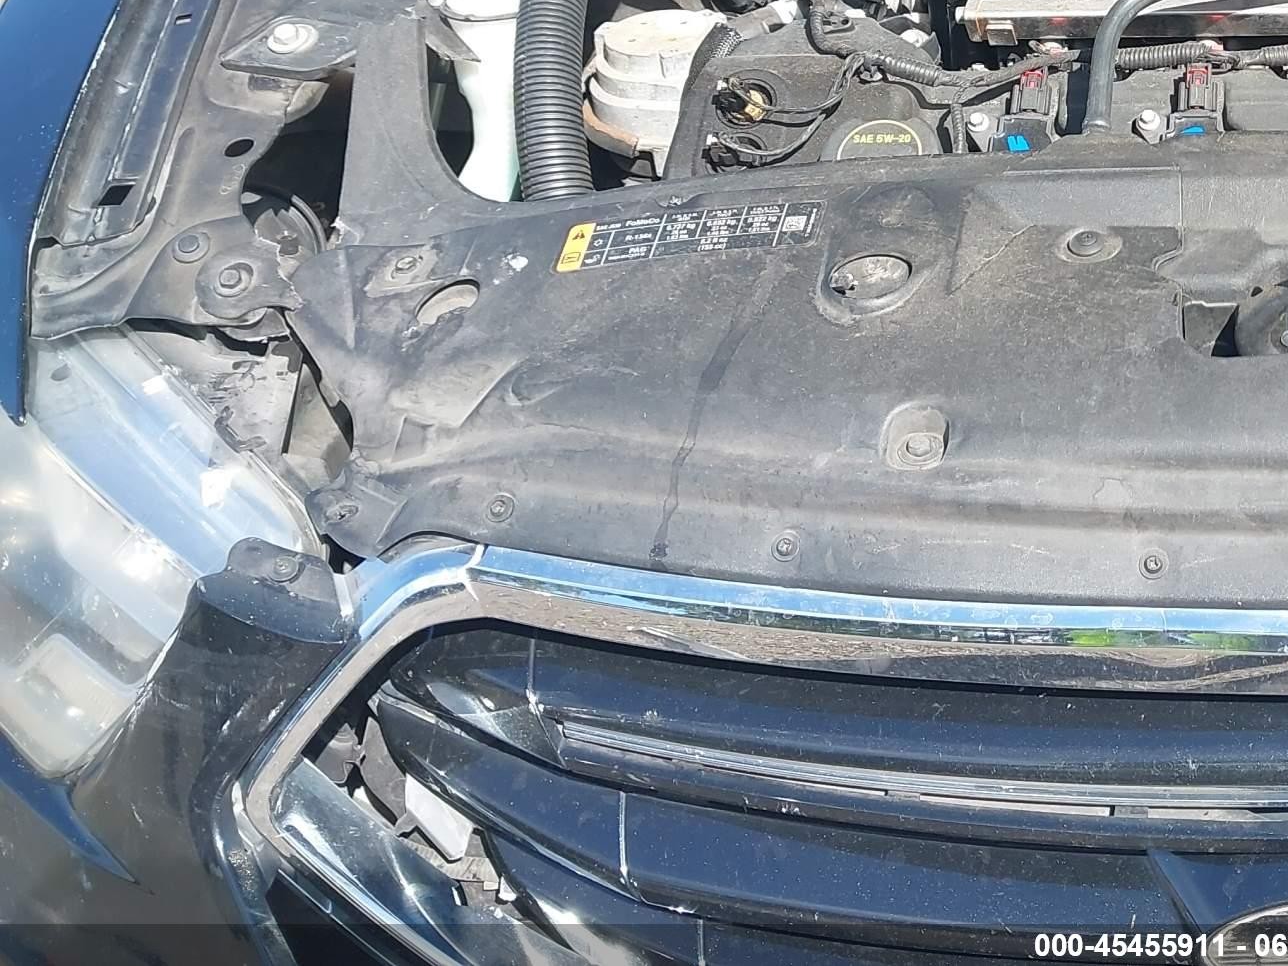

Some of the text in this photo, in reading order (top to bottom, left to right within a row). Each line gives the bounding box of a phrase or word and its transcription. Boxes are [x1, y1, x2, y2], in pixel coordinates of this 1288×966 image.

[853, 133, 911, 144] SAE 5W-20
[625, 217, 660, 227] FoMoCo
[628, 246, 647, 254] PAG
